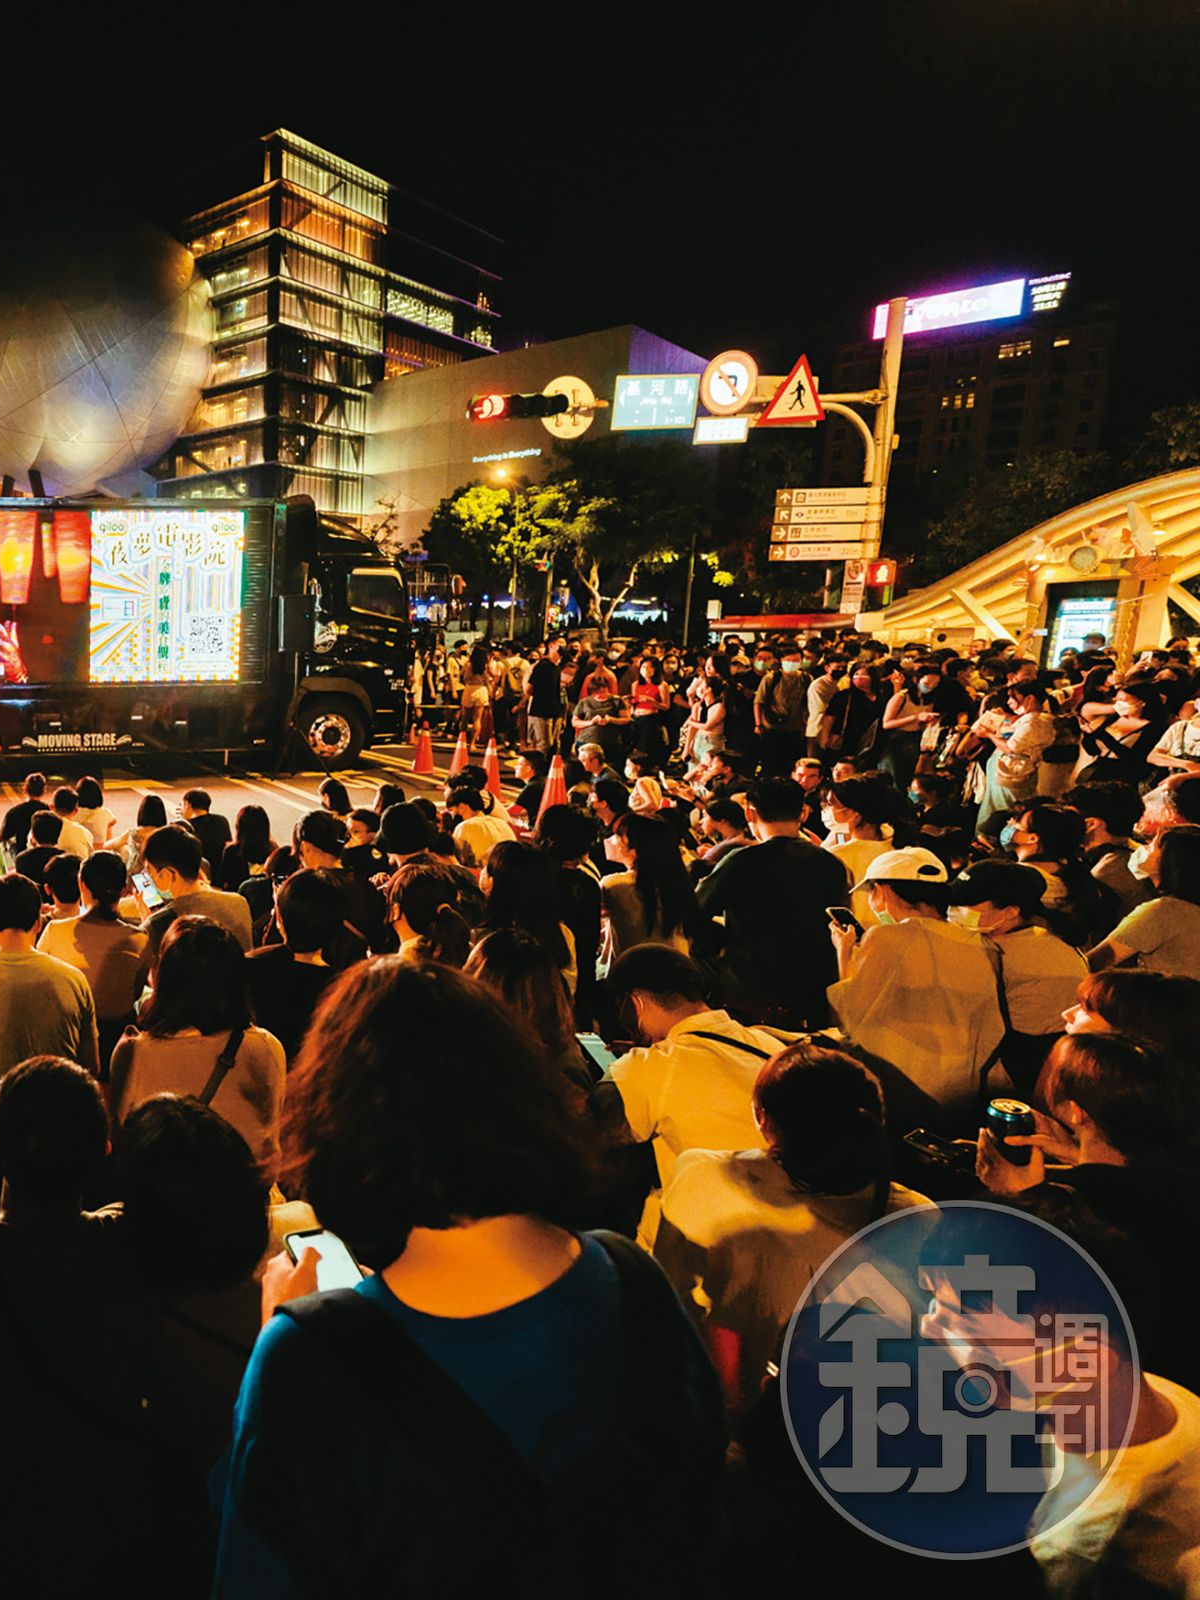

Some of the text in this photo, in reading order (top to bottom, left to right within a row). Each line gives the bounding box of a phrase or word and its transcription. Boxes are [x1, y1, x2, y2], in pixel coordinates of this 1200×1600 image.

[626, 379, 689, 396] 基河路
[38, 733, 117, 748] MOVING STAGE
